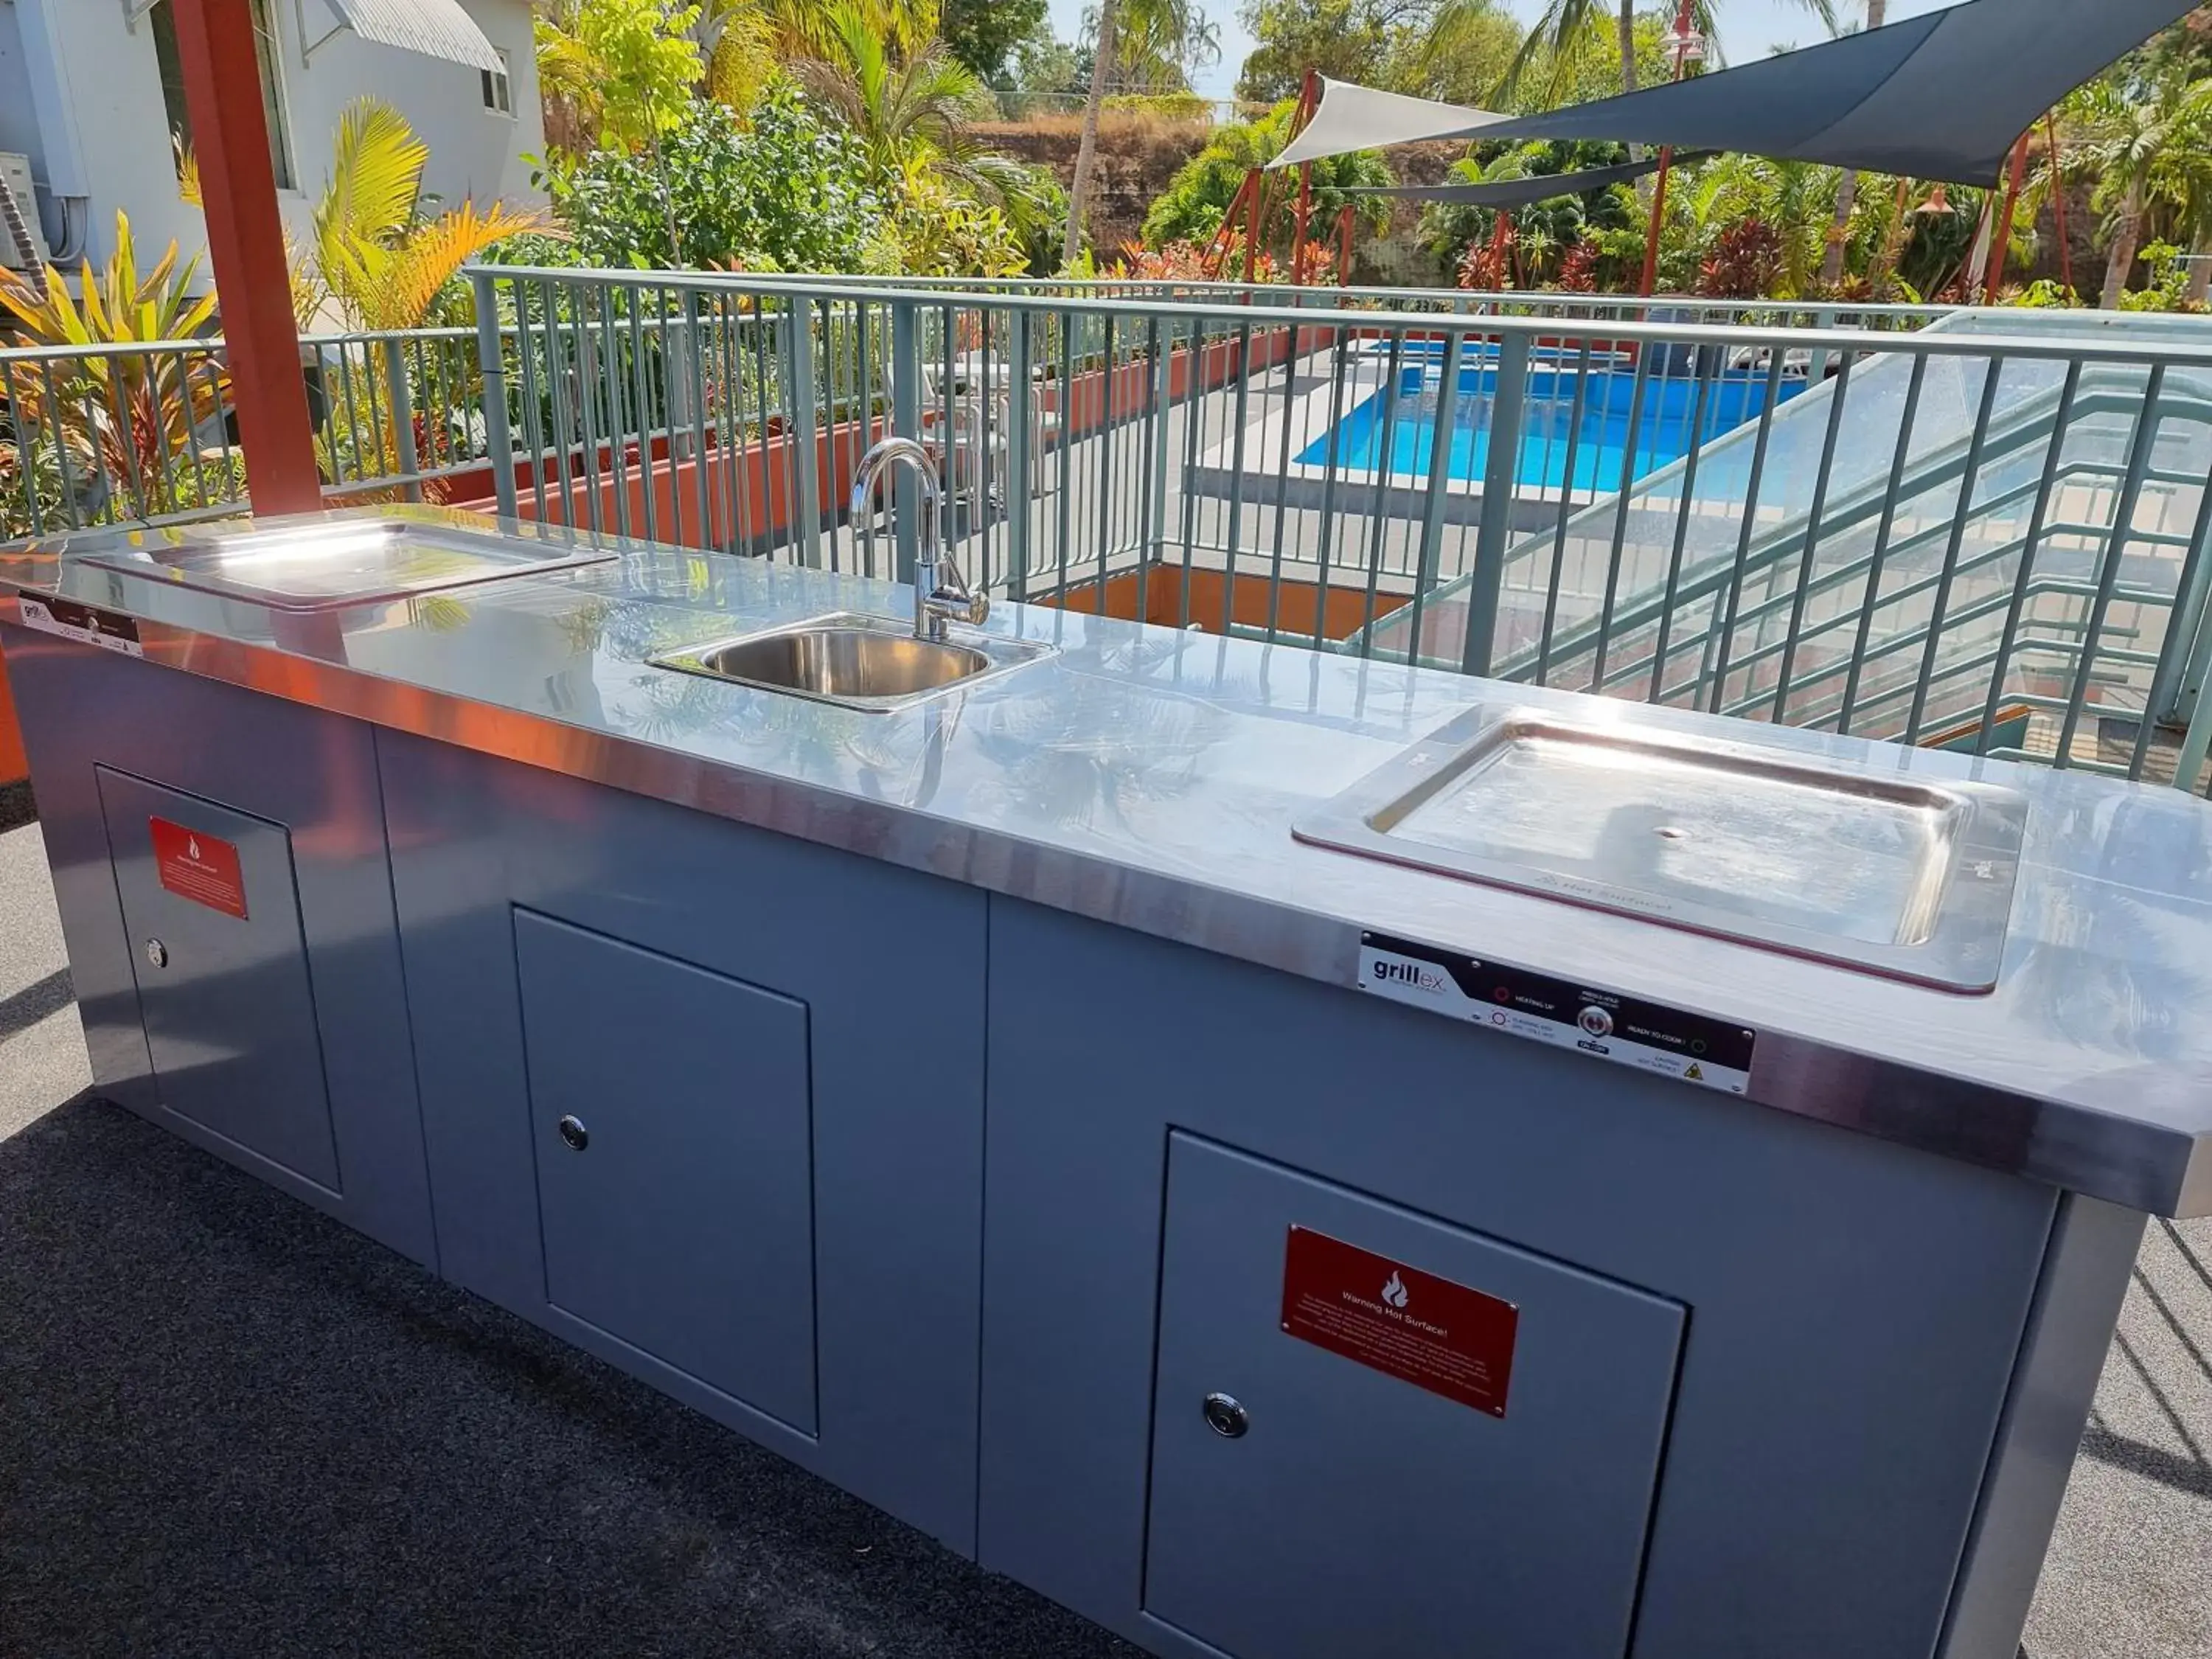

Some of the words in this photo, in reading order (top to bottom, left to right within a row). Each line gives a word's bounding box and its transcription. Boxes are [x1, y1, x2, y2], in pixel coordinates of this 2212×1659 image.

[1374, 961, 1444, 990] grillex
[1343, 1291, 1382, 1315] Warning
[1385, 1307, 1402, 1321] Hot
[1404, 1315, 1447, 1338] Surface!
